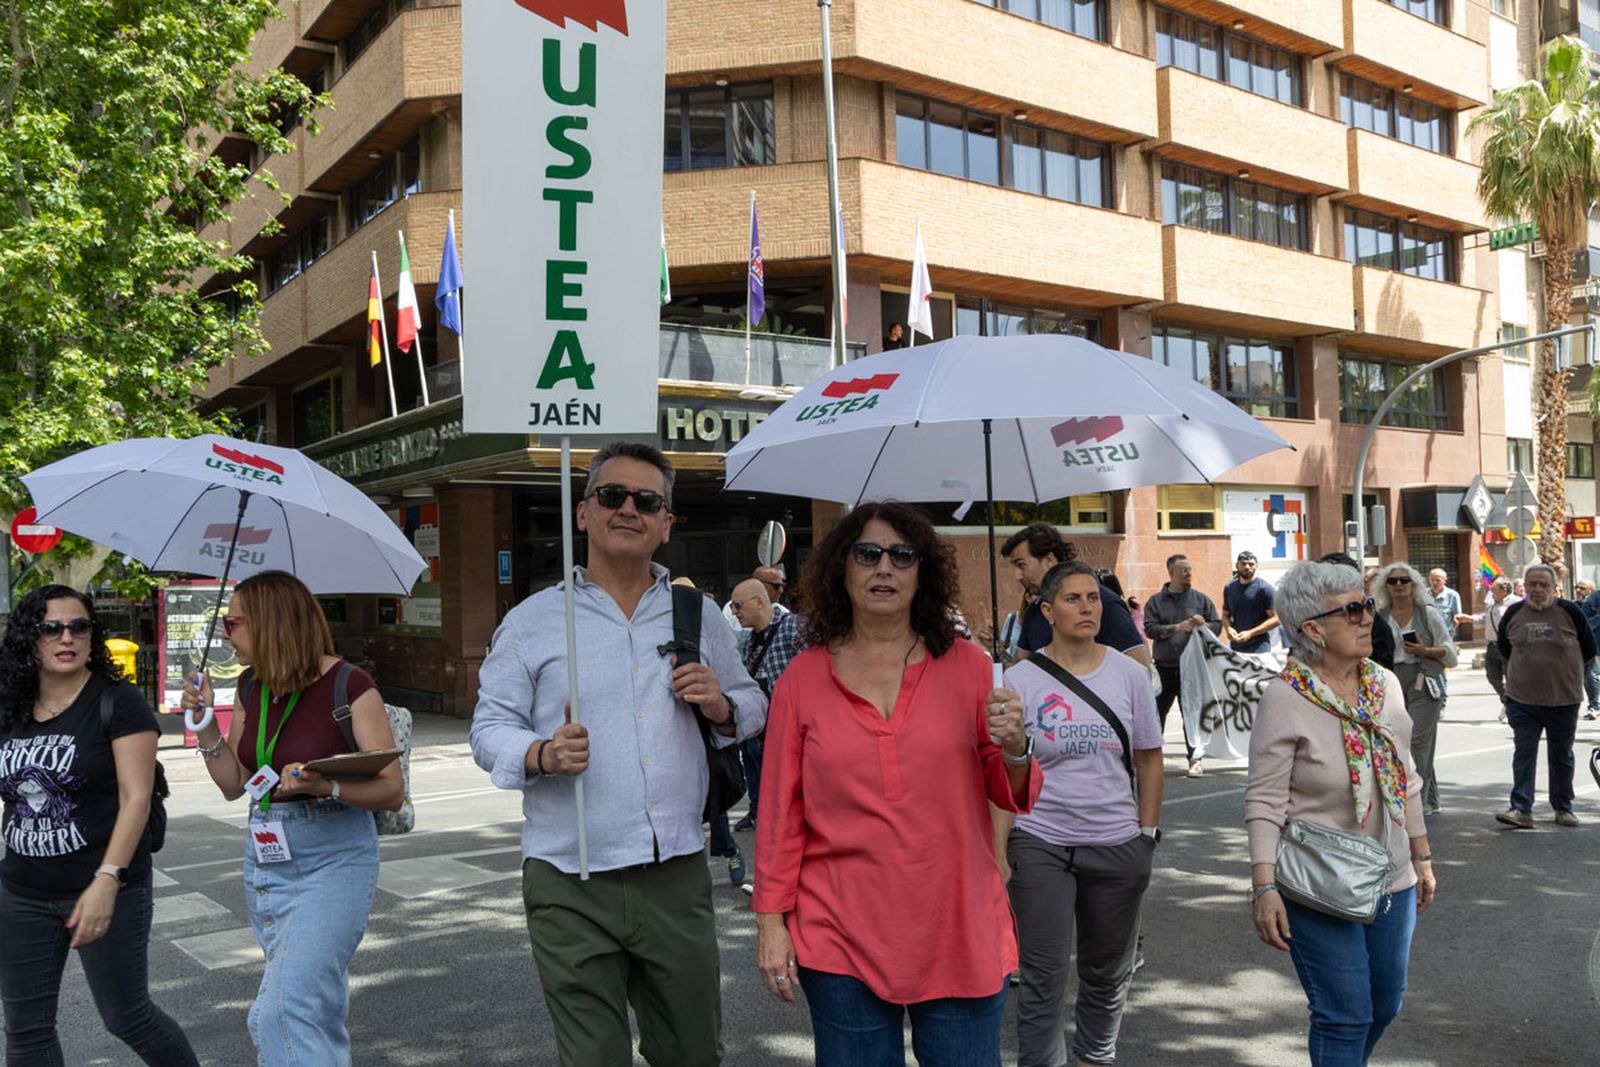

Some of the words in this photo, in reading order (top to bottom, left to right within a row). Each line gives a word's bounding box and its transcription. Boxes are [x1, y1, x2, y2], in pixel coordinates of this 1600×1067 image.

[536, 38, 597, 390] USTEA
[528, 398, 602, 426] JAÉN
[796, 394, 880, 422] USTEA
[205, 457, 283, 486] USTEA
[0, 744, 76, 778] RINCESA
